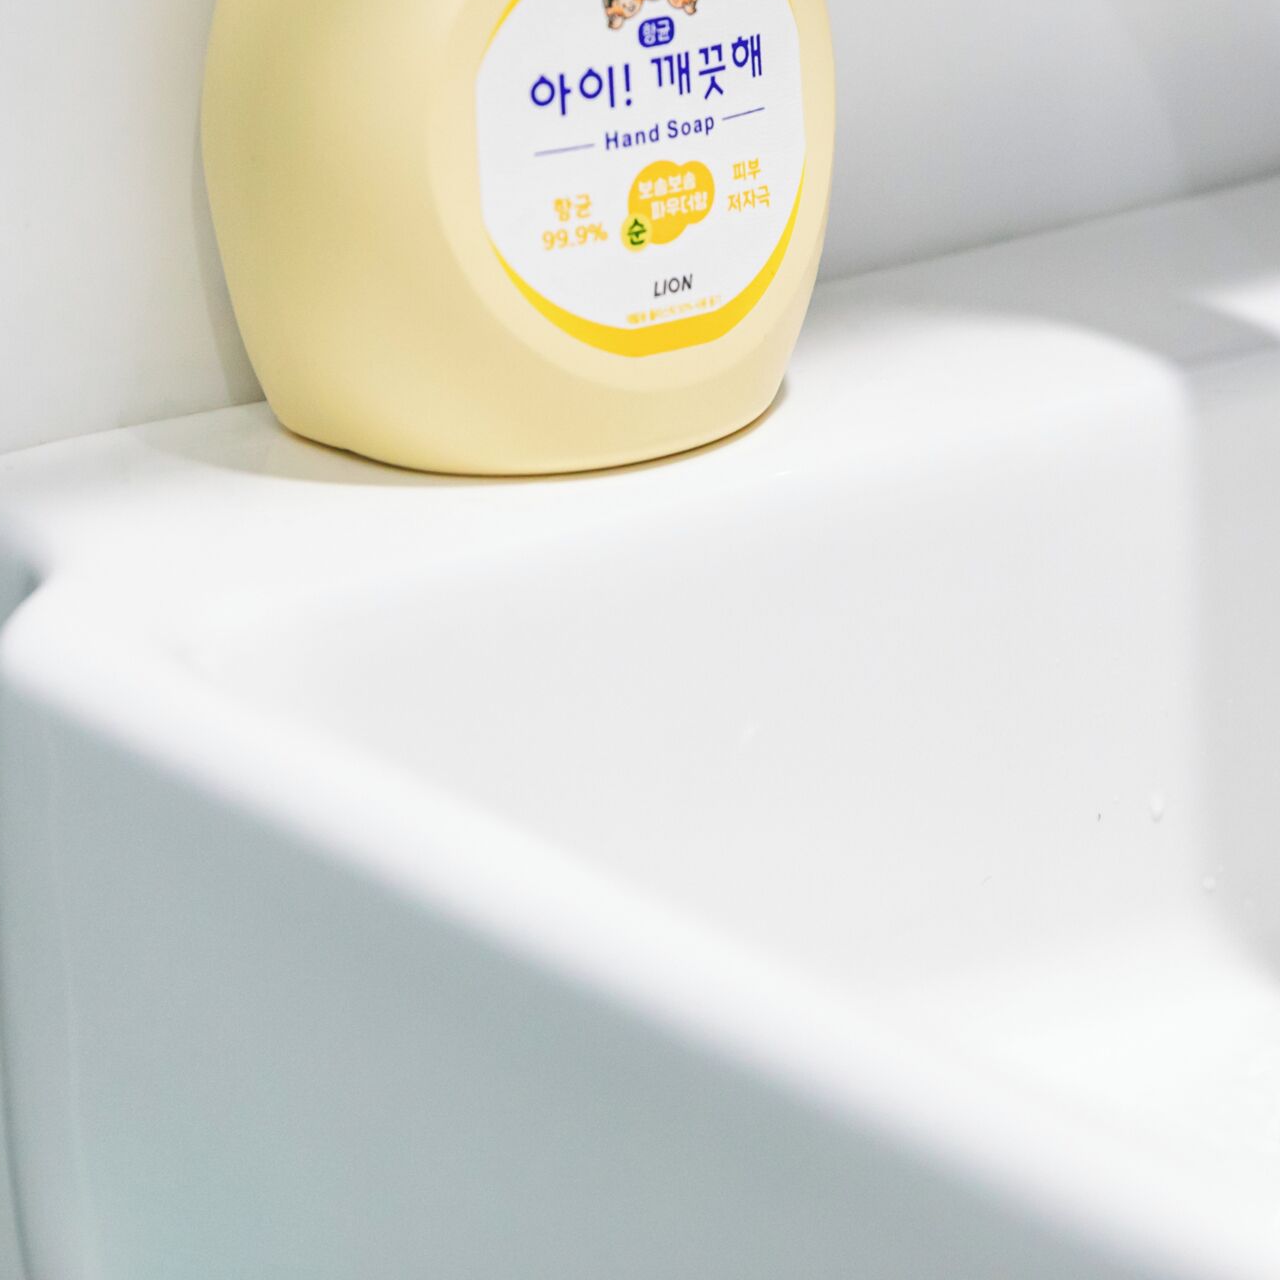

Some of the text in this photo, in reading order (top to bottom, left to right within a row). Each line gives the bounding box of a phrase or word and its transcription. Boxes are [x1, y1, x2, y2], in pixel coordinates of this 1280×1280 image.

[641, 18, 671, 45] 항균
[531, 34, 762, 116] 아이! 깨끗해
[605, 116, 715, 151] Hand Soap
[732, 158, 761, 180] 피부
[728, 184, 770, 213] 저자극
[542, 222, 608, 251] 99.9%
[627, 218, 647, 245] 순
[653, 273, 693, 298] LION
